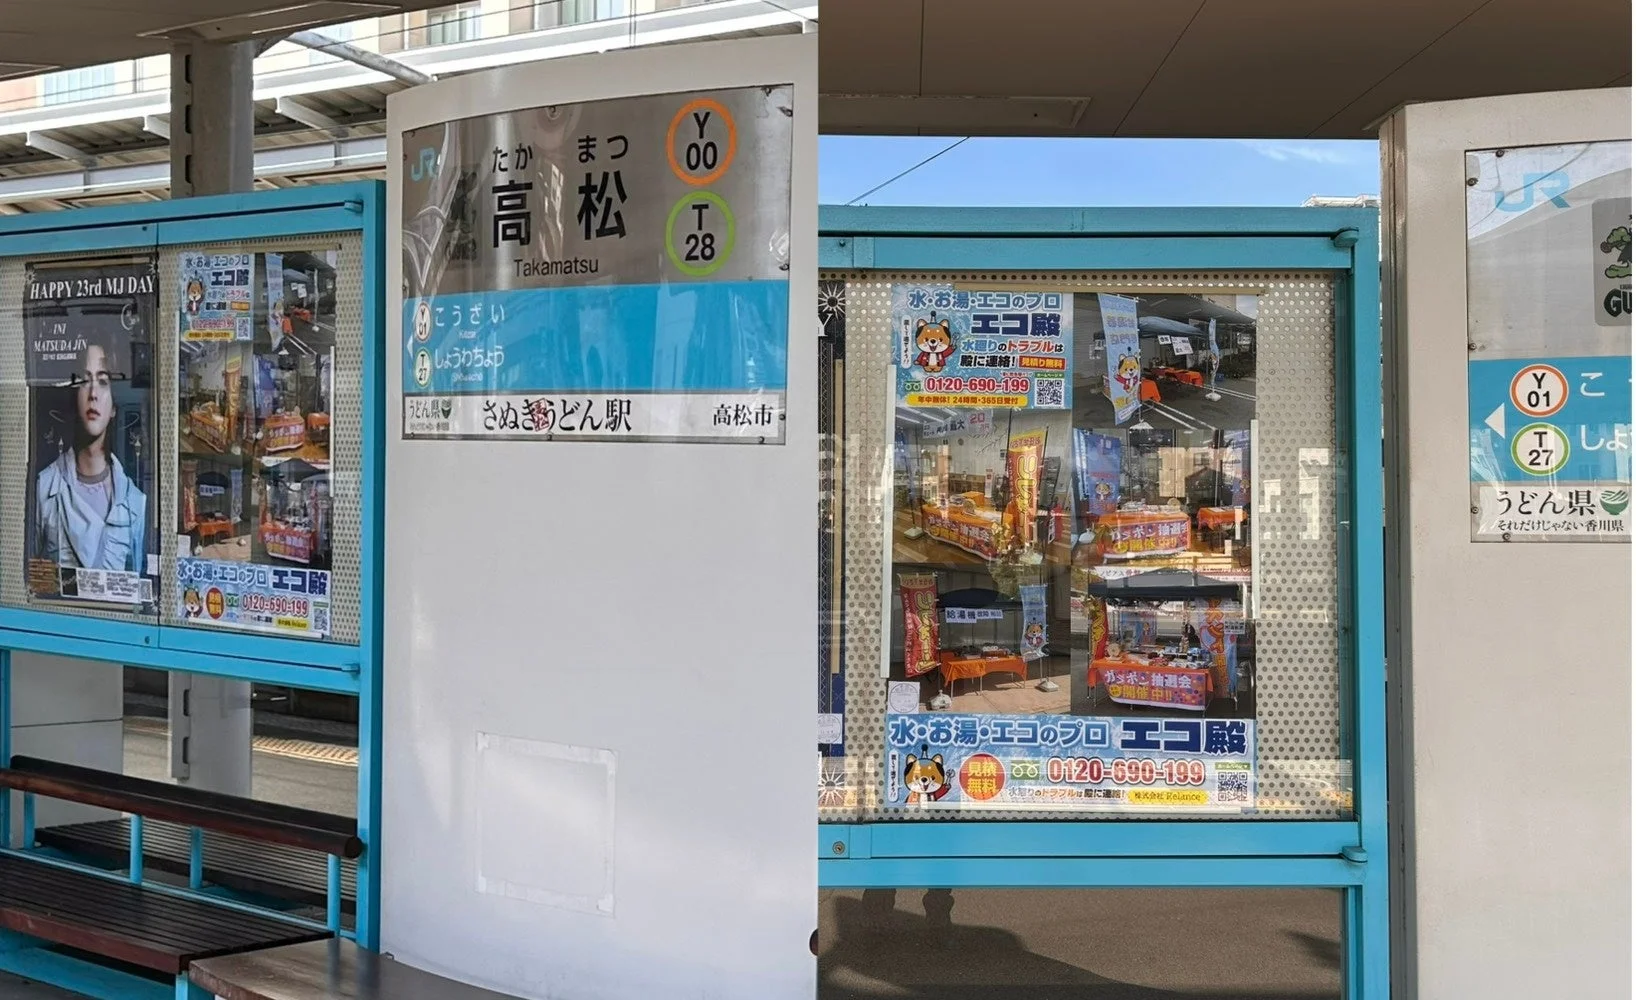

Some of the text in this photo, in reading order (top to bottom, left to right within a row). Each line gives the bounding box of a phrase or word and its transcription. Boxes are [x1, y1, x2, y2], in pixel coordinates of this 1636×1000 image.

[693, 112, 710, 140] Y
[686, 141, 718, 171] 00
[1495, 172, 1570, 213] JR
[491, 170, 628, 249] 高松
[692, 204, 708, 230] T
[685, 233, 715, 263] 28
[514, 256, 599, 278] Takamatsu
[30, 275, 156, 300] HAPPY 23rd MJ DAY
[909, 289, 1061, 310] 水・お湯・エコのプロ
[420, 308, 426, 320] Y
[435, 304, 505, 327] こうざい
[971, 312, 1061, 337] エコ殿
[419, 323, 427, 336] 01
[33, 339, 72, 353] MATSUDA
[435, 345, 504, 369] しょうわちょう
[961, 340, 1063, 353] 水廻りのトラブルは
[420, 354, 426, 366] T
[419, 368, 427, 381] 27
[925, 377, 1030, 394] 0120-690-199
[1531, 373, 1546, 388] Y
[409, 398, 440, 419] うどん県
[1528, 390, 1551, 408] 01
[483, 398, 632, 433] さぬきうどん駅
[713, 401, 773, 427] 高松市
[1533, 431, 1548, 448] T
[1581, 424, 1632, 451] しょ
[1528, 449, 1554, 467] 27
[1497, 490, 1596, 516] うどん県
[1497, 519, 1624, 533] それだけじゃない香川県
[272, 569, 328, 596] エコ殿
[242, 593, 308, 617] 0120-690-199
[890, 718, 1248, 756] 水・お湯・エコのプロ エコ殿
[967, 761, 997, 777] 見積
[1048, 758, 1205, 784] 0120-690-199
[967, 778, 997, 793] 無料
